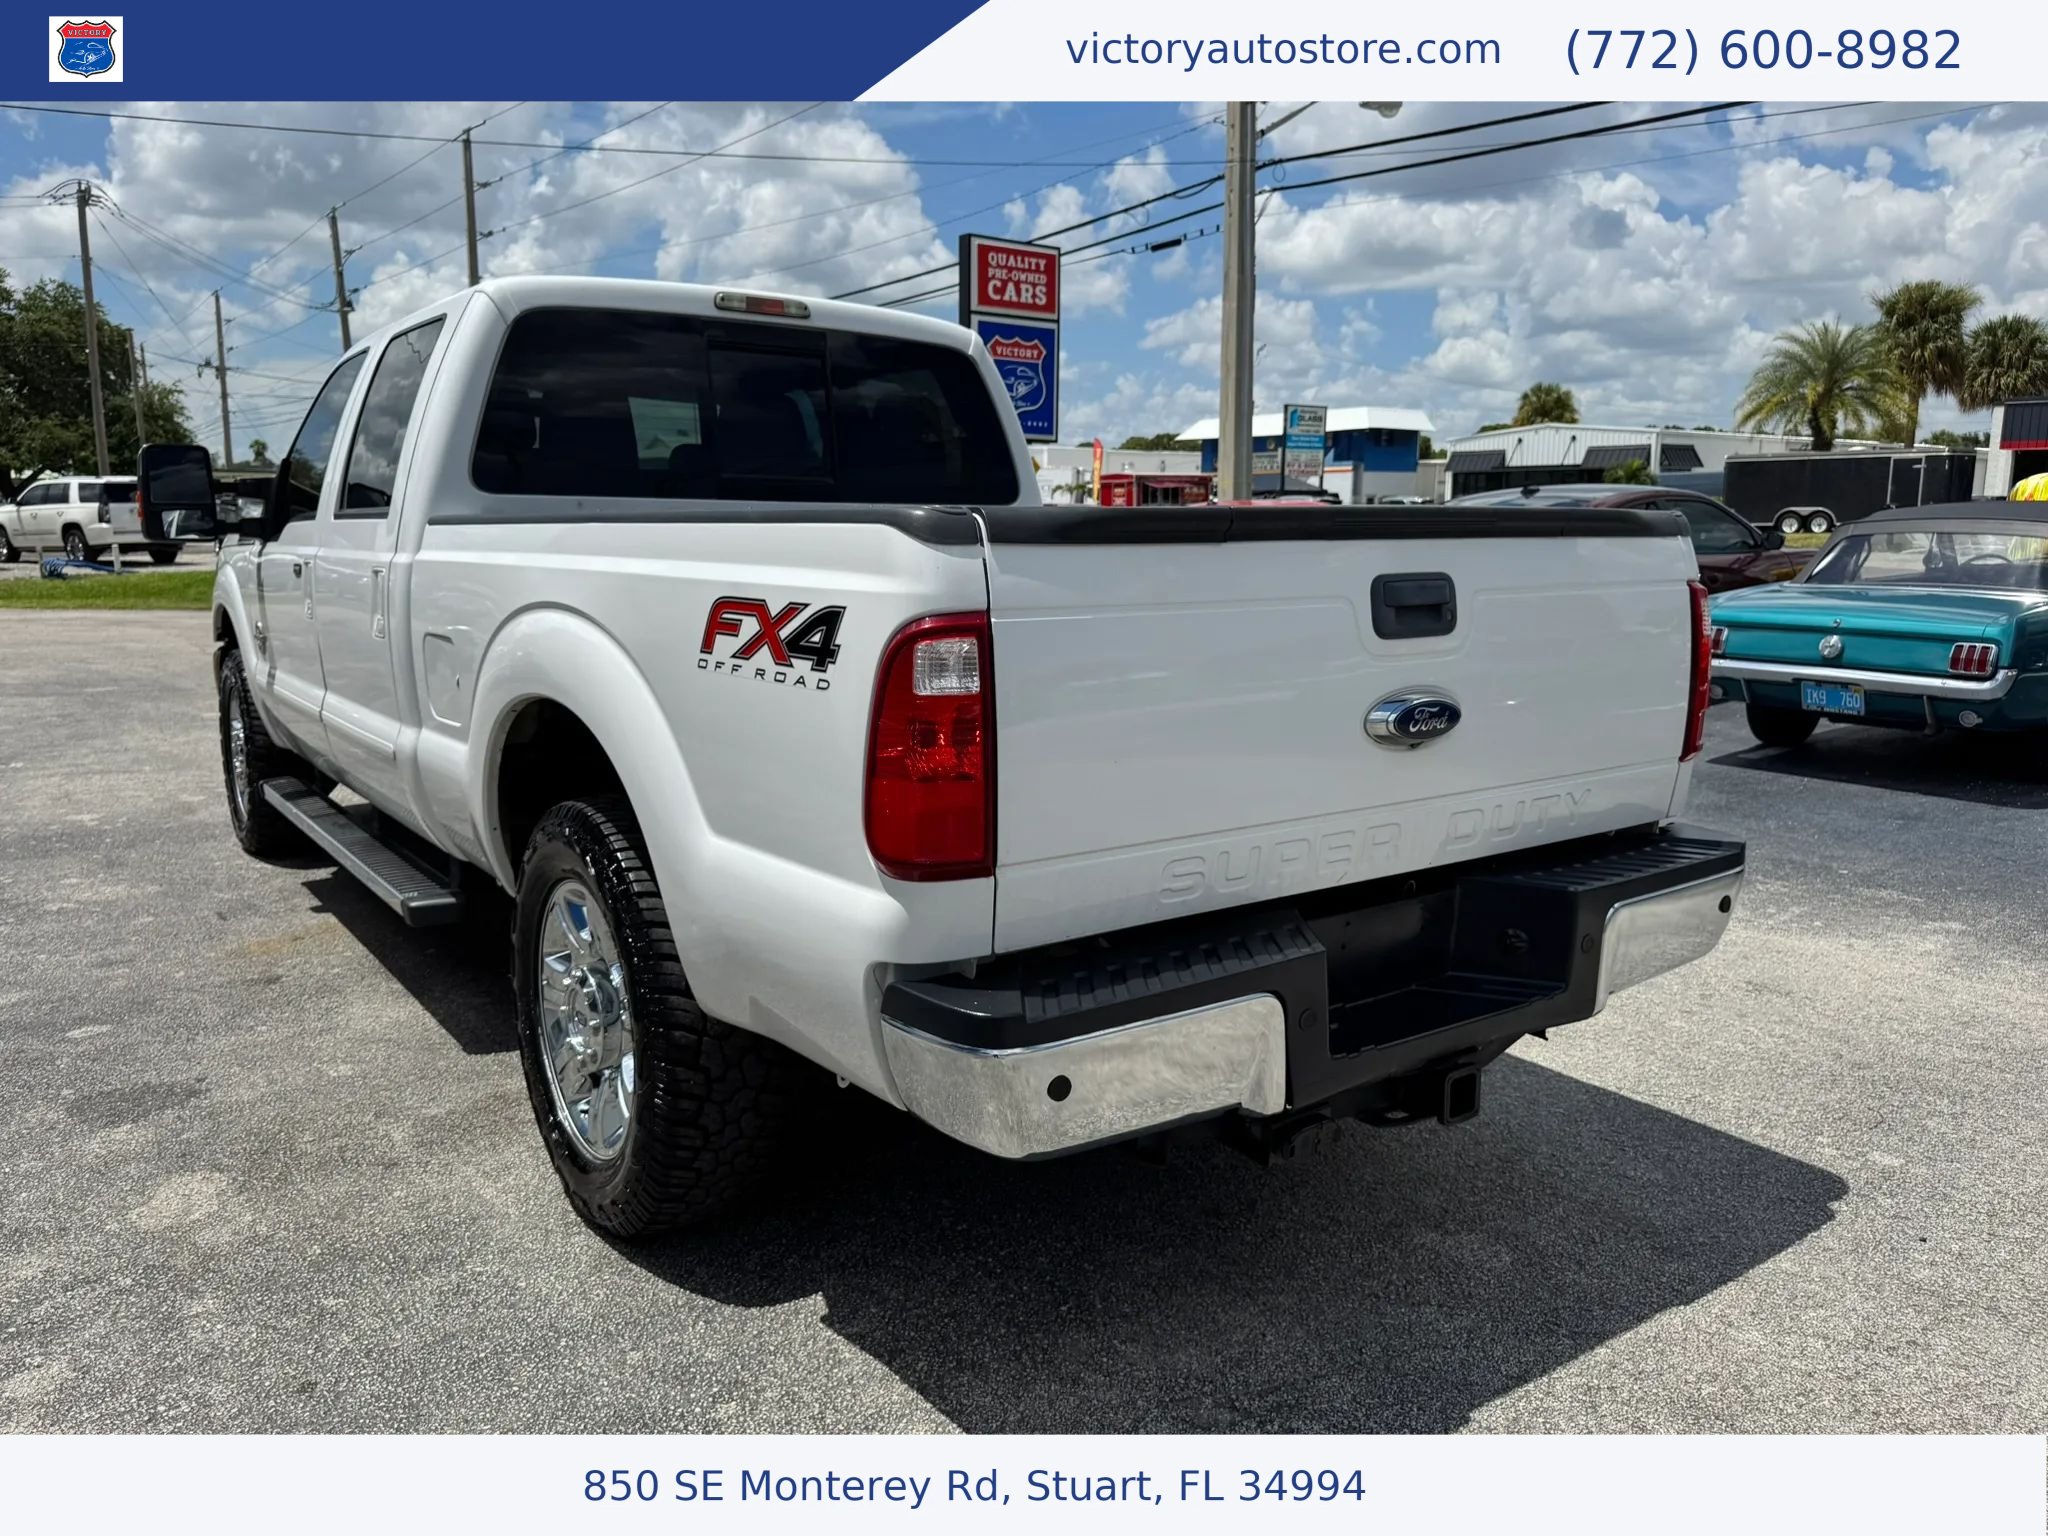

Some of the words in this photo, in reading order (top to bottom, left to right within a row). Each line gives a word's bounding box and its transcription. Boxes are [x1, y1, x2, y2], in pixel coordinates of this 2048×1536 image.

[988, 252, 1047, 272] QUALITY
[988, 267, 1047, 285] PRE-OWNED
[988, 280, 1047, 305] CARS
[996, 346, 1039, 358] VICTORY
[700, 595, 847, 674] FX4
[697, 658, 742, 675] OFF
[754, 667, 831, 691] ROAD
[1806, 688, 1827, 705] IK9
[1839, 691, 1861, 708] 760
[1409, 706, 1449, 733] Ford
[1159, 822, 1401, 902] SUPER
[1446, 789, 1592, 850] DUTY
